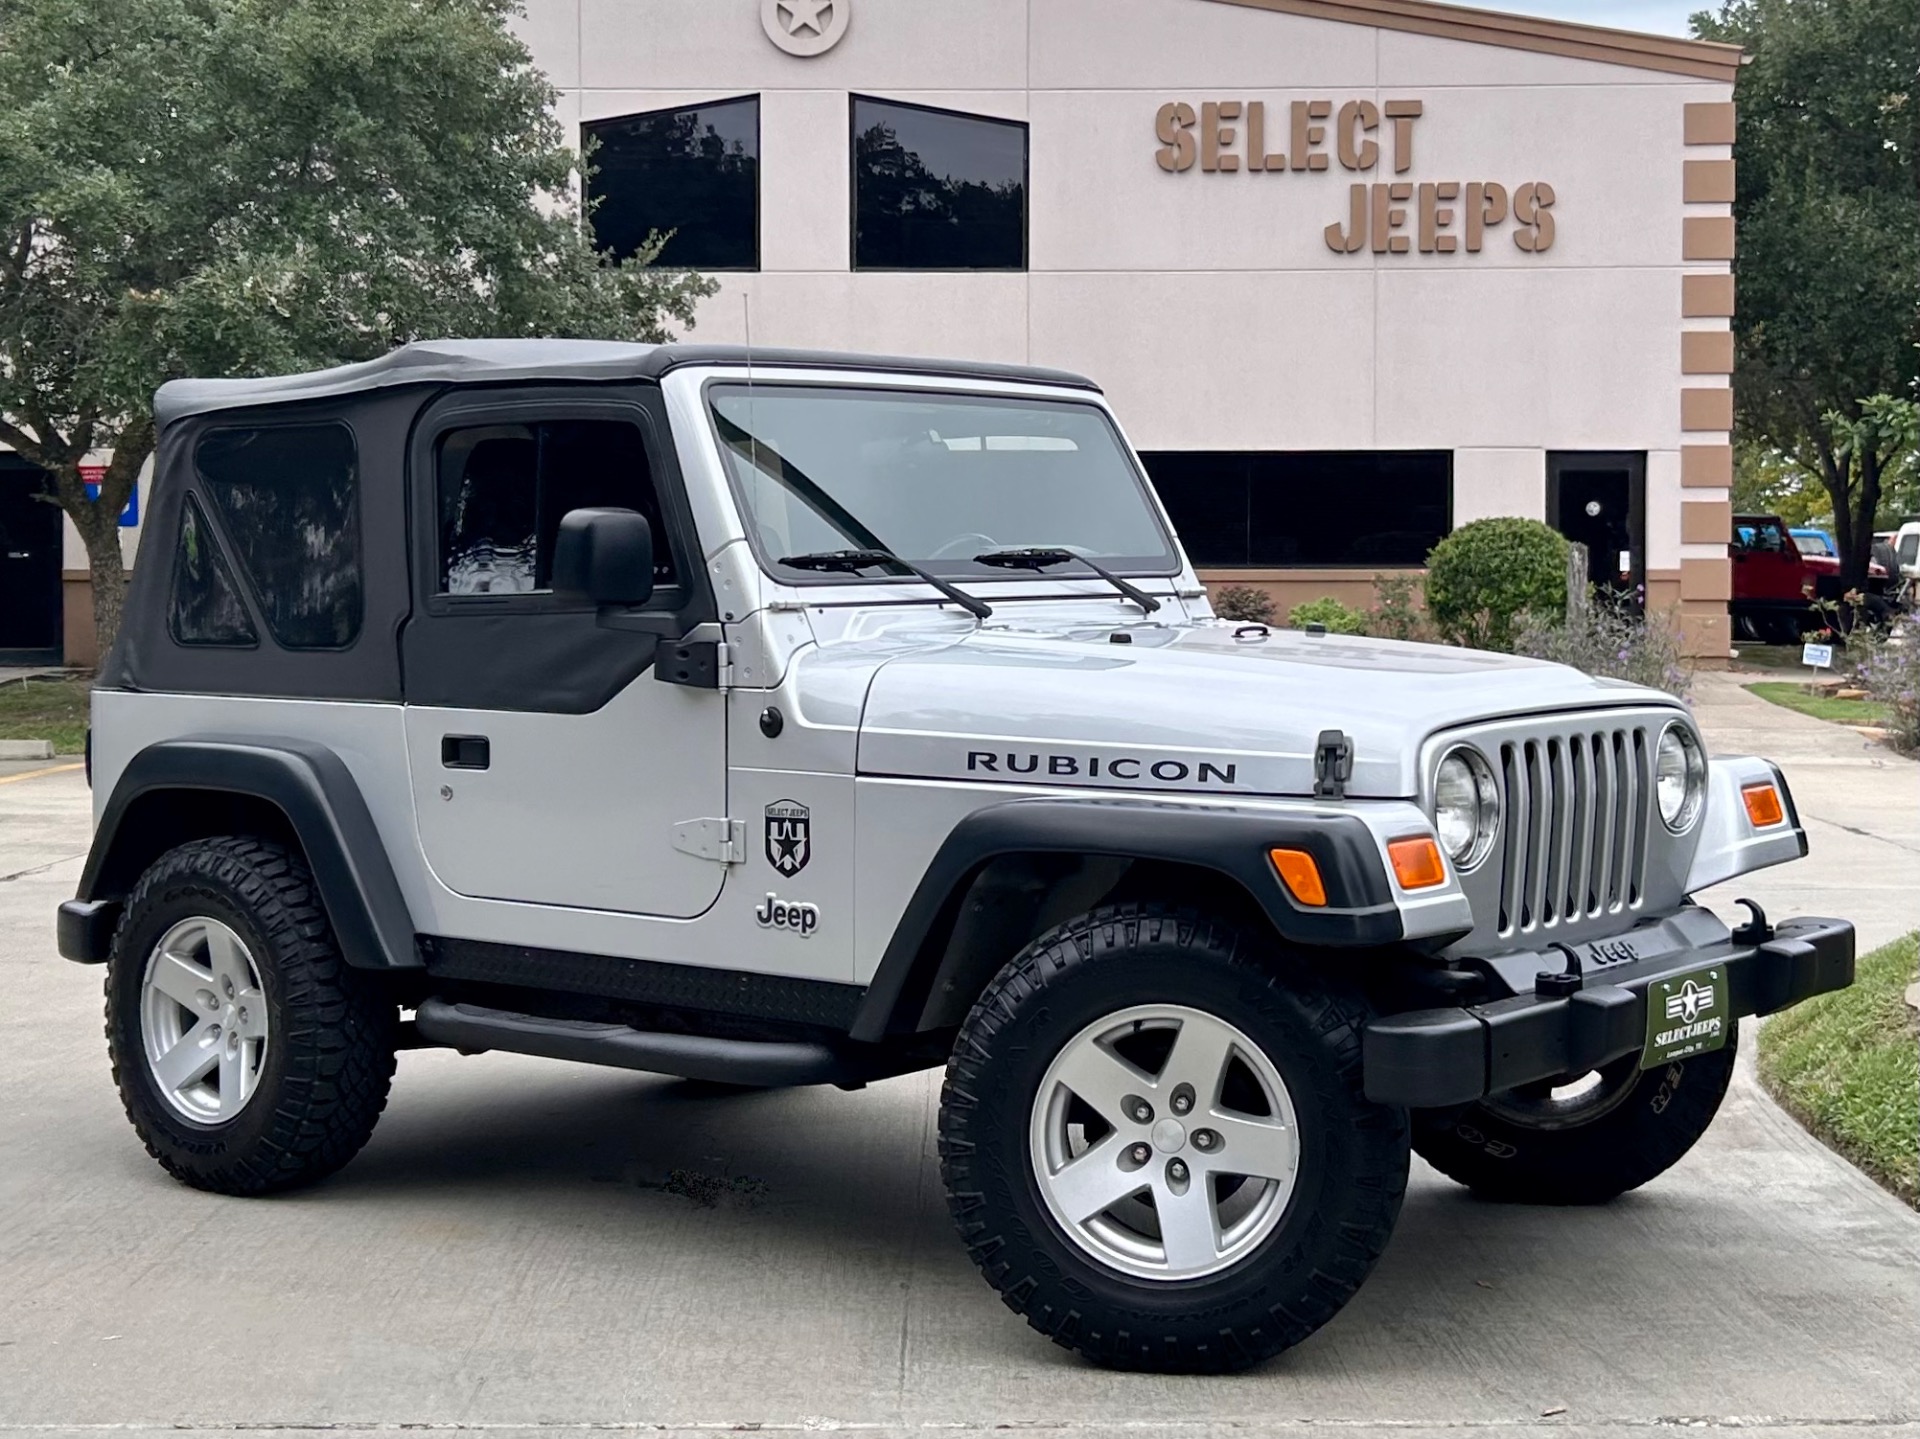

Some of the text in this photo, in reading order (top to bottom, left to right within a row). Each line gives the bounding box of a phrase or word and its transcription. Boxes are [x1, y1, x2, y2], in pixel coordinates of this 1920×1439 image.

[1155, 100, 1423, 173] SELECT
[1324, 182, 1556, 253] JEEPS
[967, 751, 1236, 784] RUBICON
[767, 808, 808, 817] SELECT JEEPS
[756, 893, 819, 937] Jeep
[1588, 941, 1639, 965] Jeep
[1654, 1016, 1721, 1047] SELECTJEEPS
